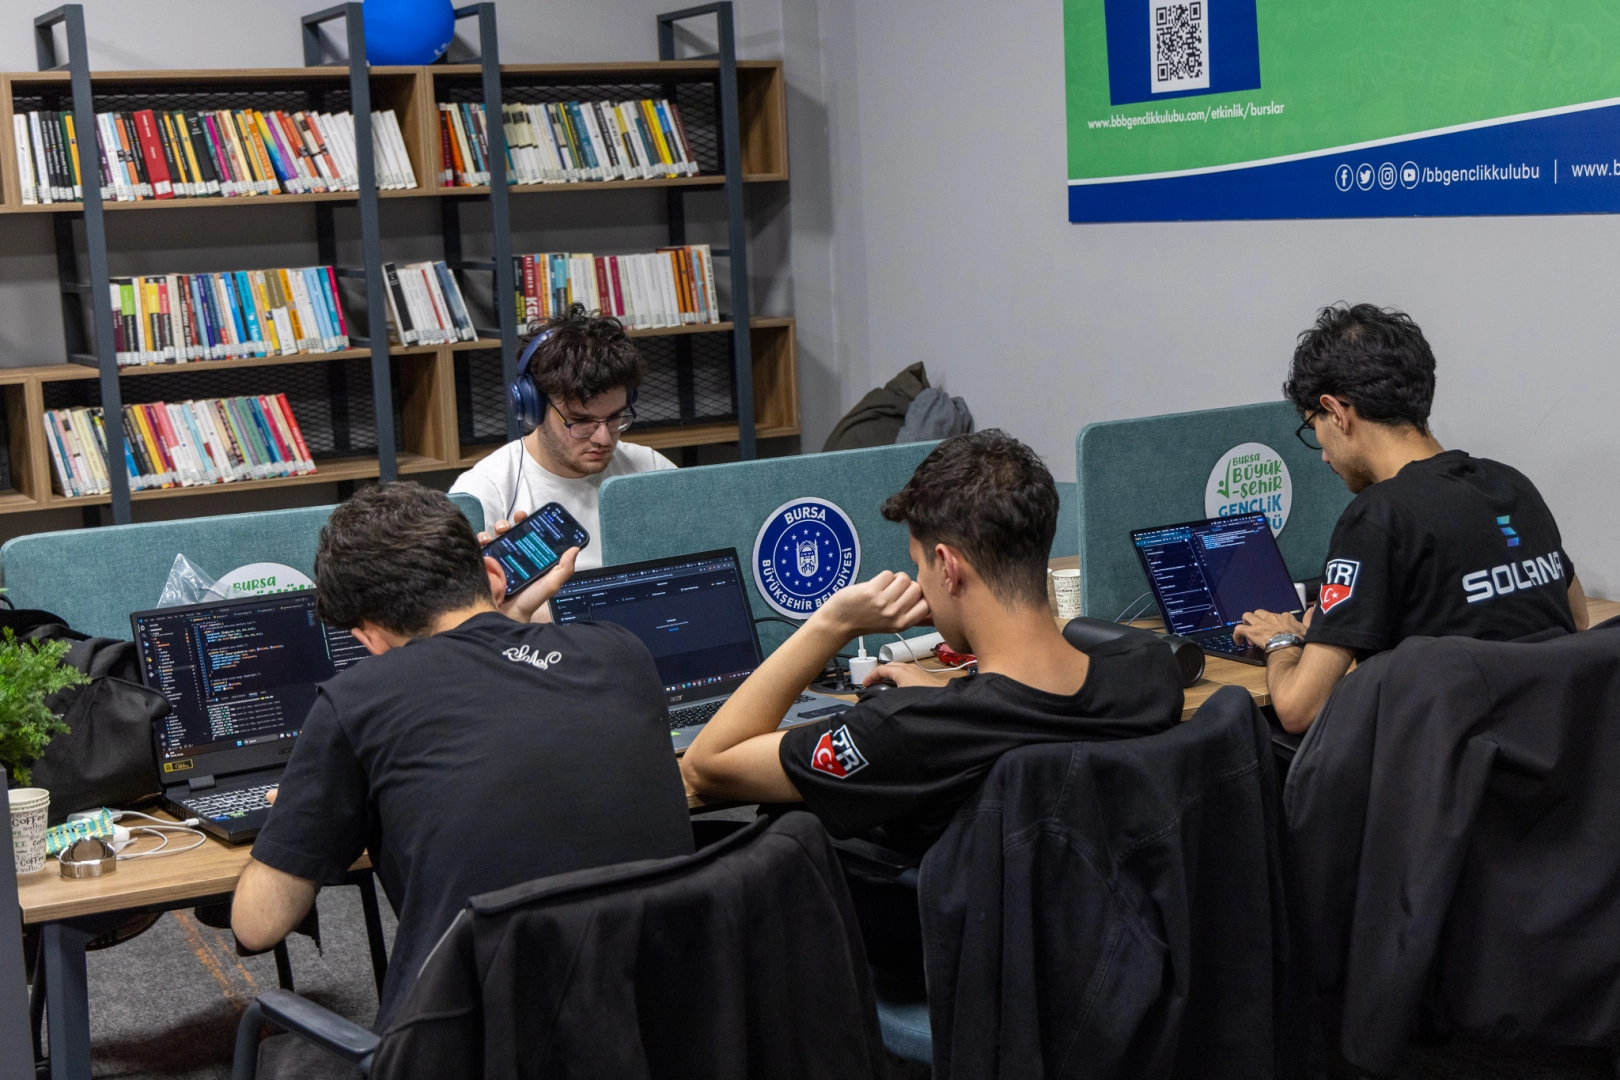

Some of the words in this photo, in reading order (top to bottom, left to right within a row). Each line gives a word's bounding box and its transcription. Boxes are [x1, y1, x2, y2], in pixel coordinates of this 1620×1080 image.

[1087, 101, 1284, 129] www.bbbgenclikkulubu.com/etkinlik/burslar
[1421, 163, 1540, 186] /bbgenclikkulubu
[784, 507, 826, 525] BURSA
[762, 559, 813, 611] BÜYÜKŞEHİR
[1326, 563, 1353, 586] TR
[1462, 551, 1564, 604] SOLANA
[669, 694, 684, 703] acer
